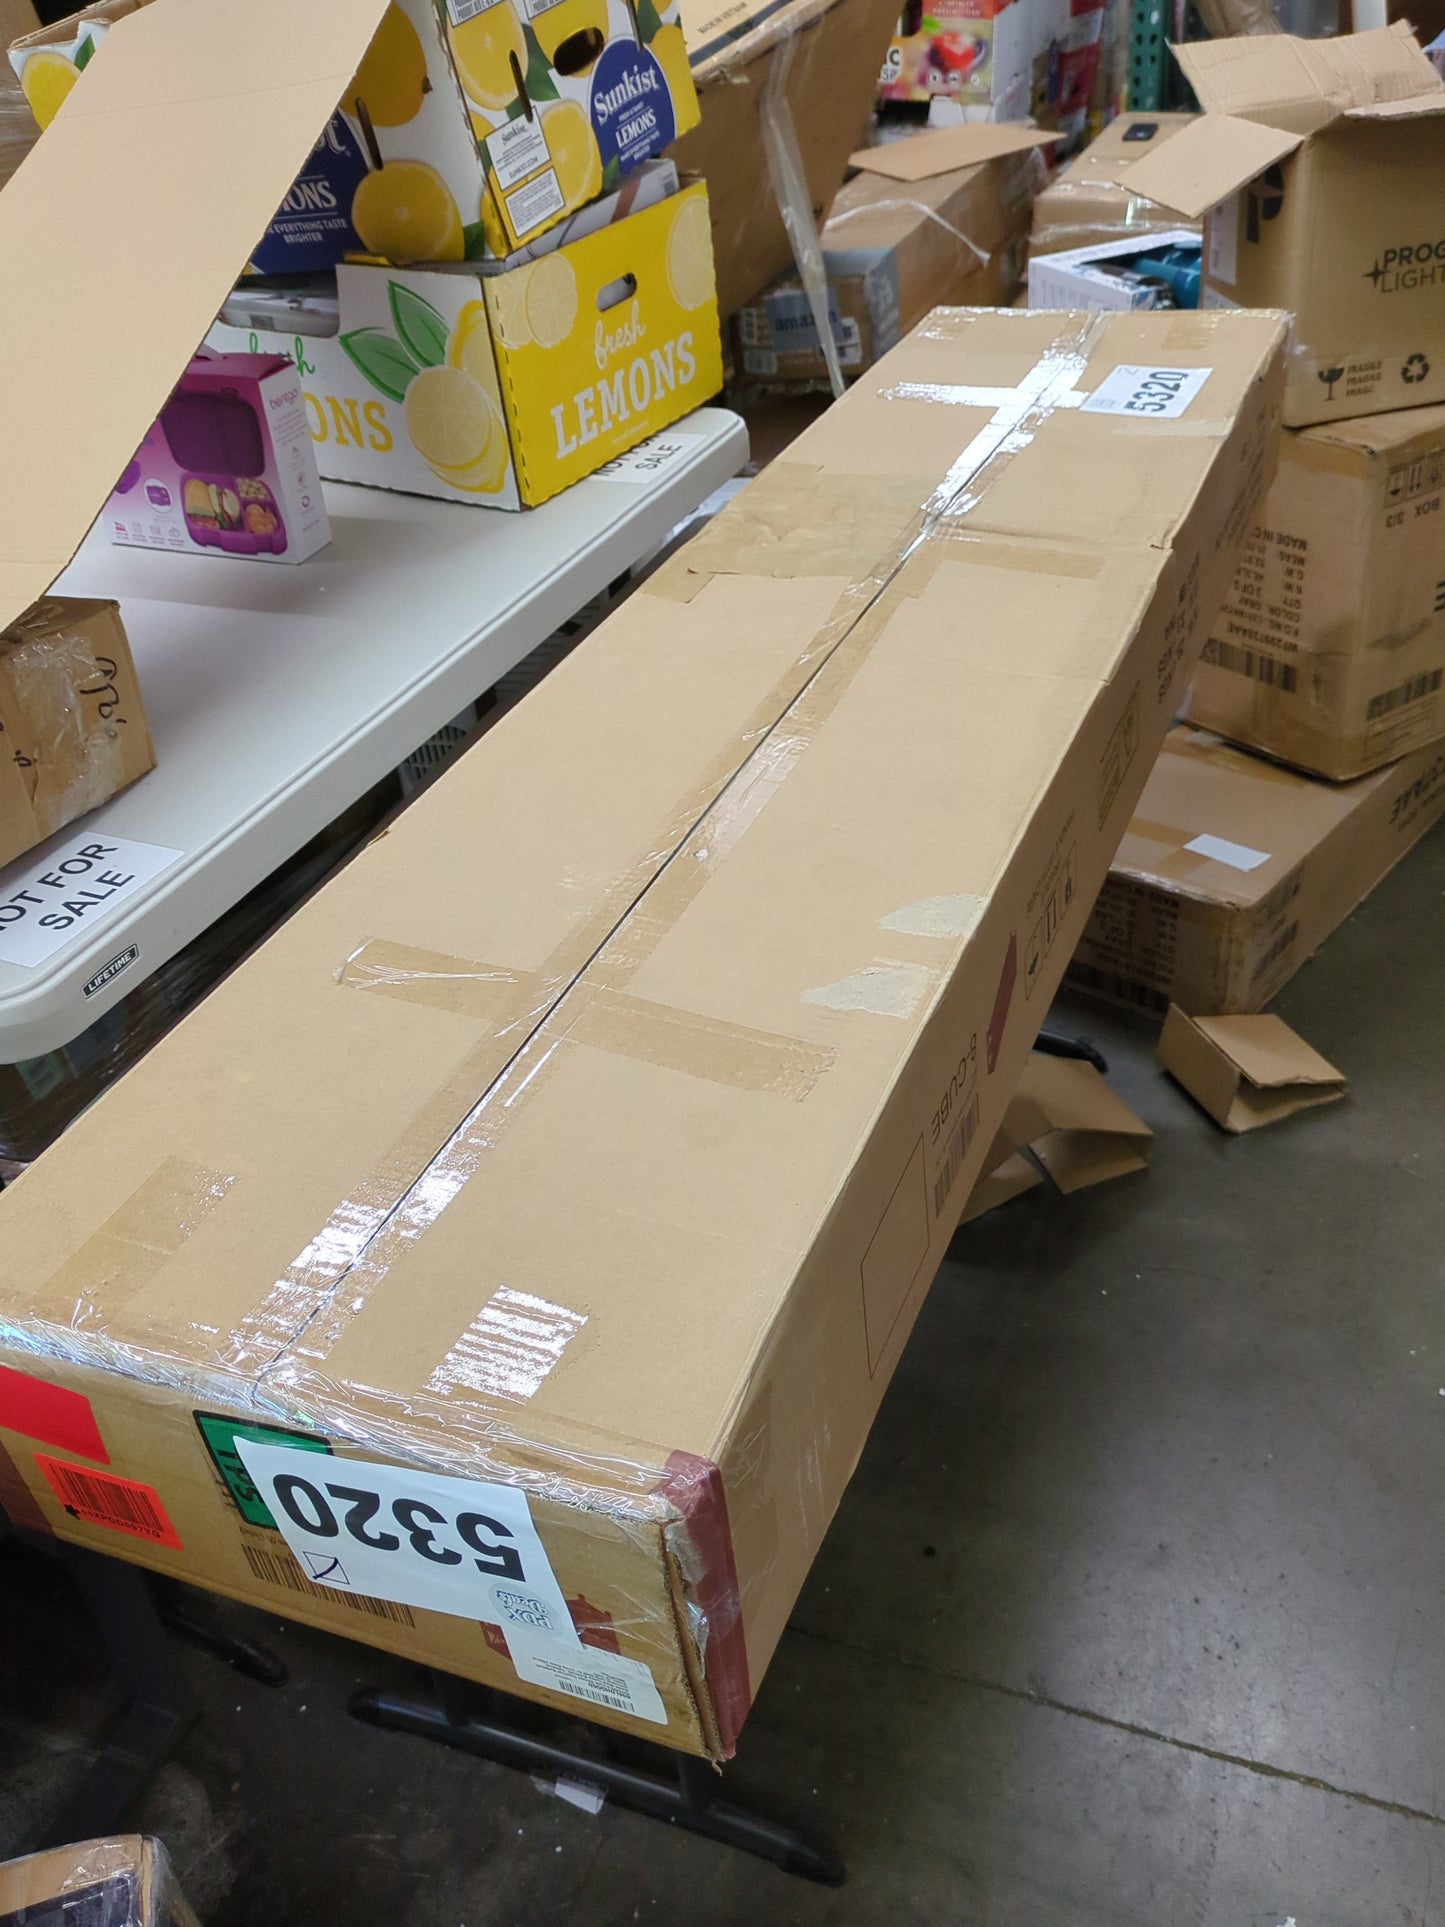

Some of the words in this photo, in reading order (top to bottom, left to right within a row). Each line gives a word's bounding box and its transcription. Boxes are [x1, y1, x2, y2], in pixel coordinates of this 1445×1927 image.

[593, 64, 661, 125] Sunkist
[615, 108, 657, 149] LEMONS
[274, 220, 324, 234] EVERYTHING
[323, 217, 348, 230] TASTE
[593, 300, 646, 370] fresh
[549, 331, 697, 460] LEMONS
[1123, 370, 1190, 415] 5320
[634, 443, 682, 470] SALE
[1276, 532, 1308, 551] MADE
[0, 888, 46, 931] OT
[38, 843, 119, 890] FOR
[38, 869, 136, 931] SALE
[86, 951, 133, 993] LIFETIME
[931, 1032, 978, 1146] 8-CUBE
[271, 1473, 527, 1582] 5320
[496, 1590, 552, 1617] Deals
[508, 1606, 554, 1631] PDX
